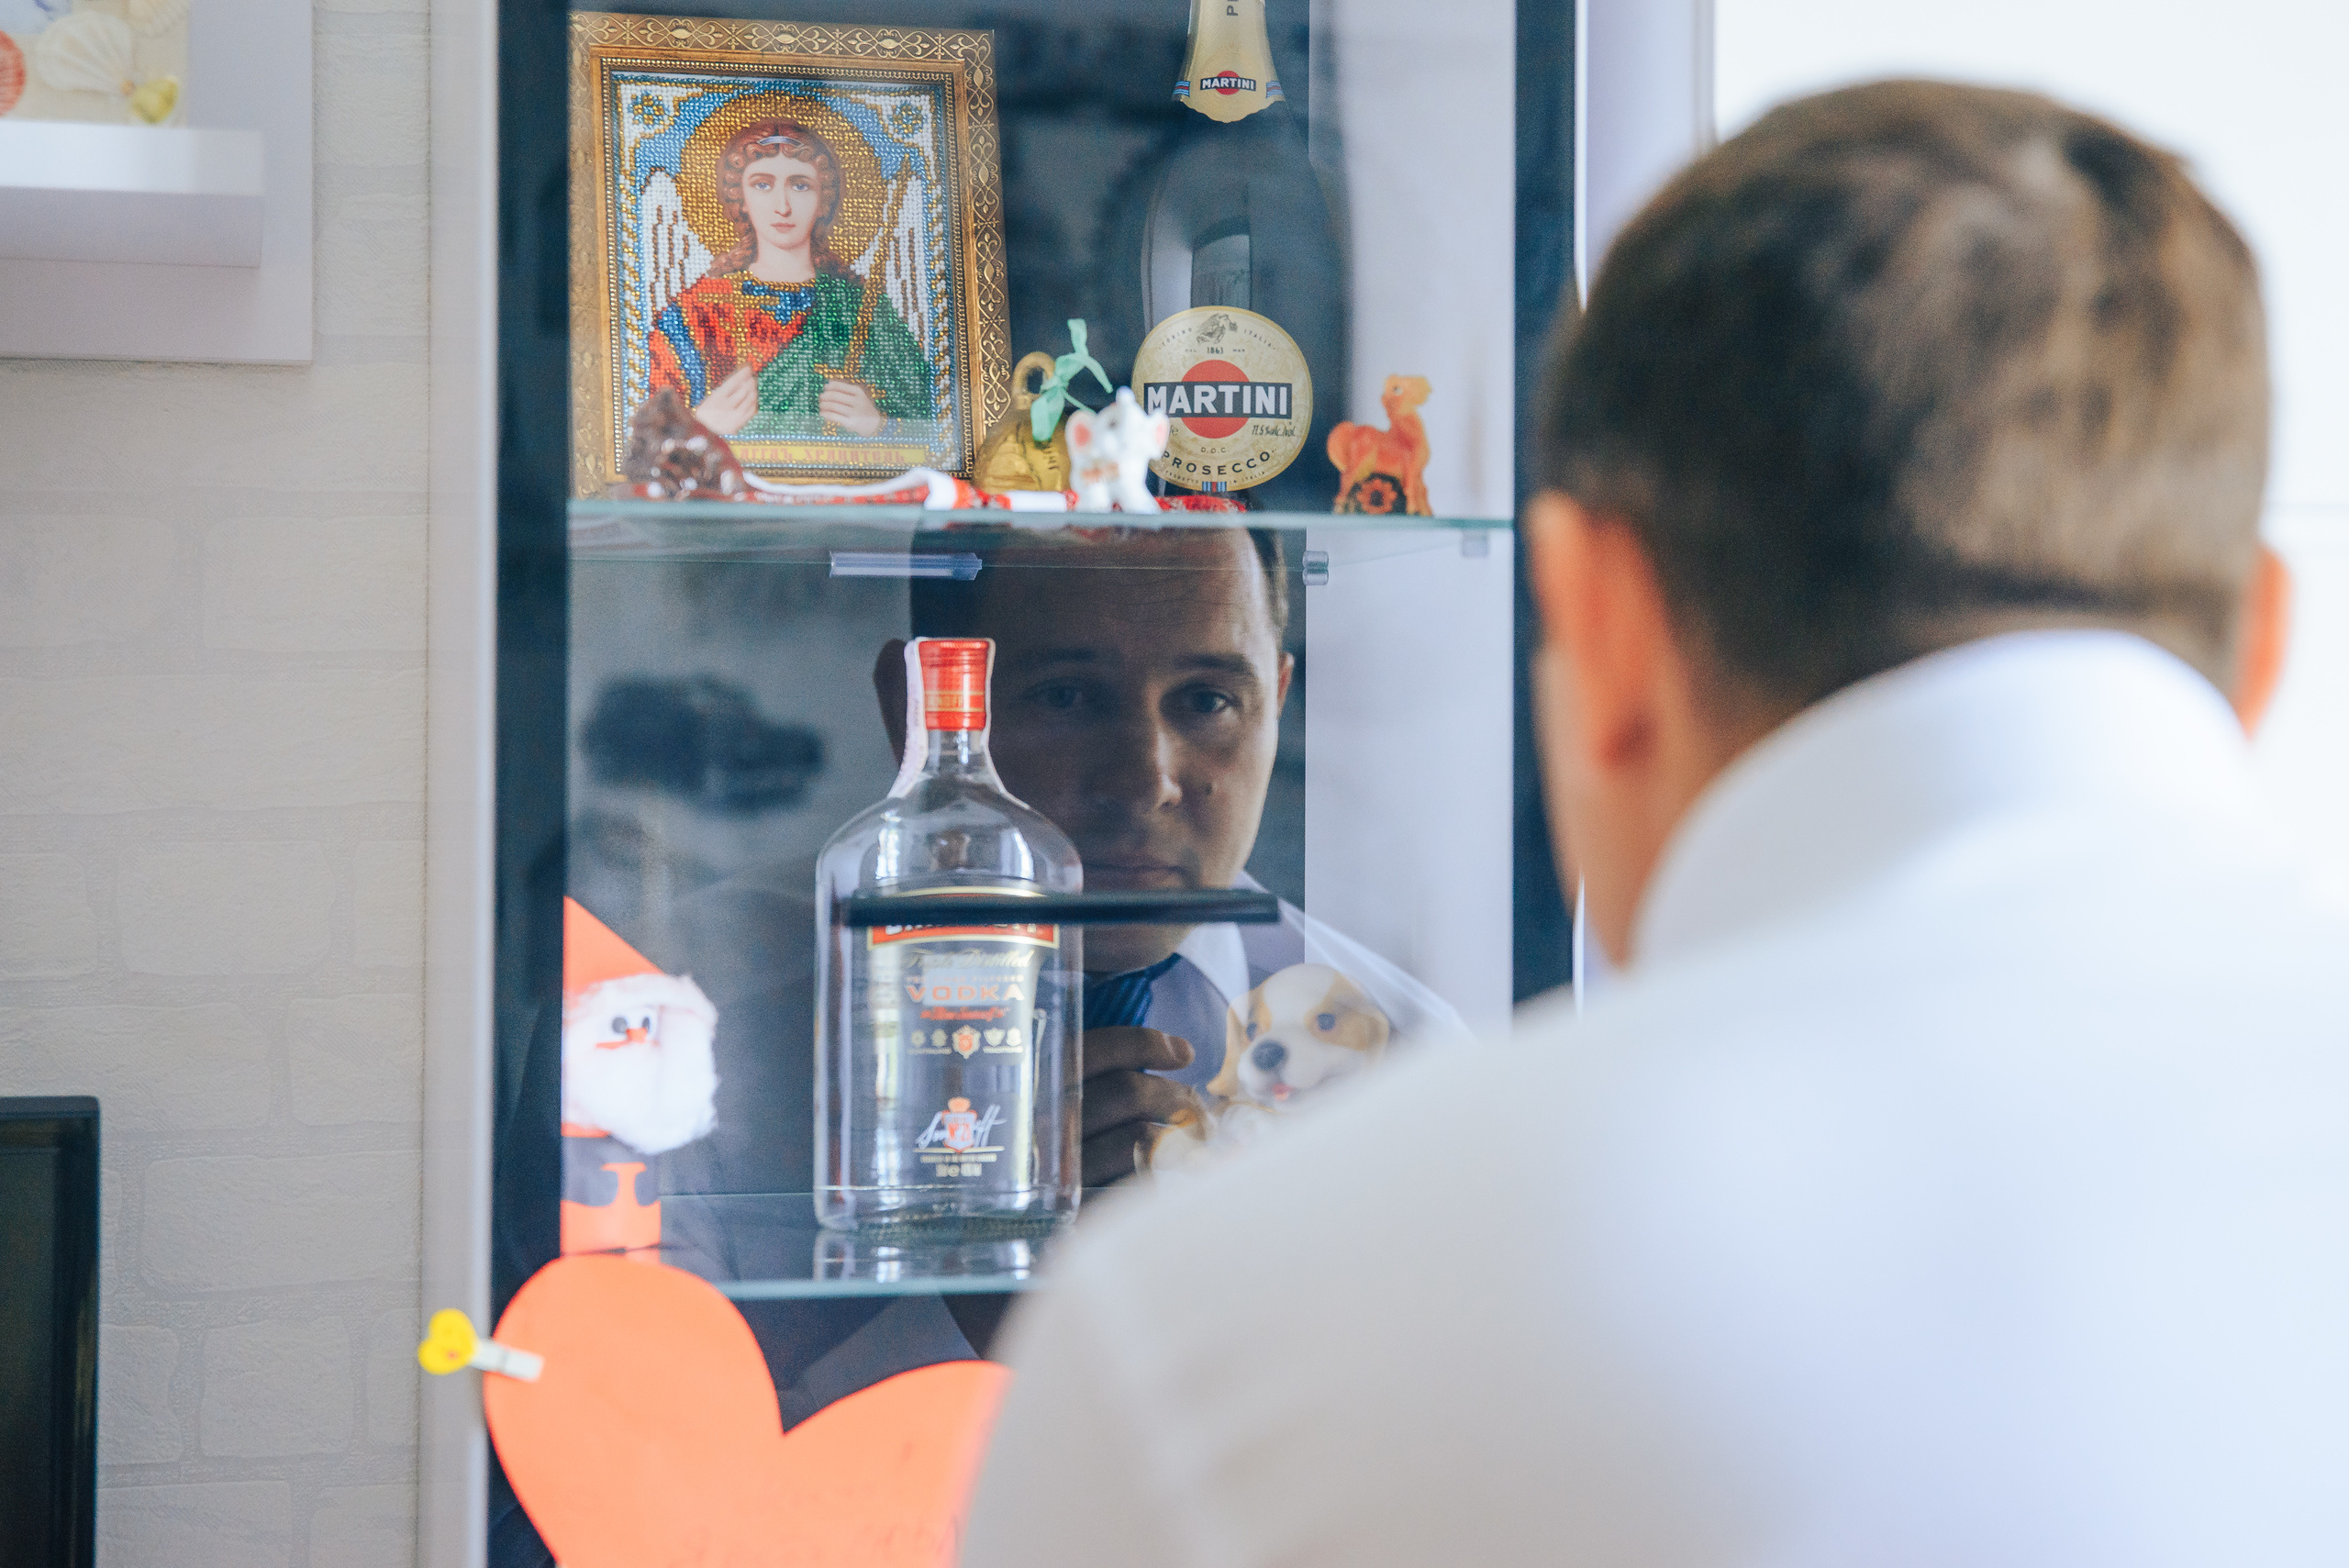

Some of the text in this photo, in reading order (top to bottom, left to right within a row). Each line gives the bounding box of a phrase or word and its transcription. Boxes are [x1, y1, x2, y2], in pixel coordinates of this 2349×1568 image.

[1202, 79, 1255, 90] MARTINI
[1207, 347, 1224, 355] 1863
[1147, 384, 1287, 416] MARTINI
[1162, 450, 1271, 475] PROSECCO
[905, 983, 1026, 1003] VODKA
